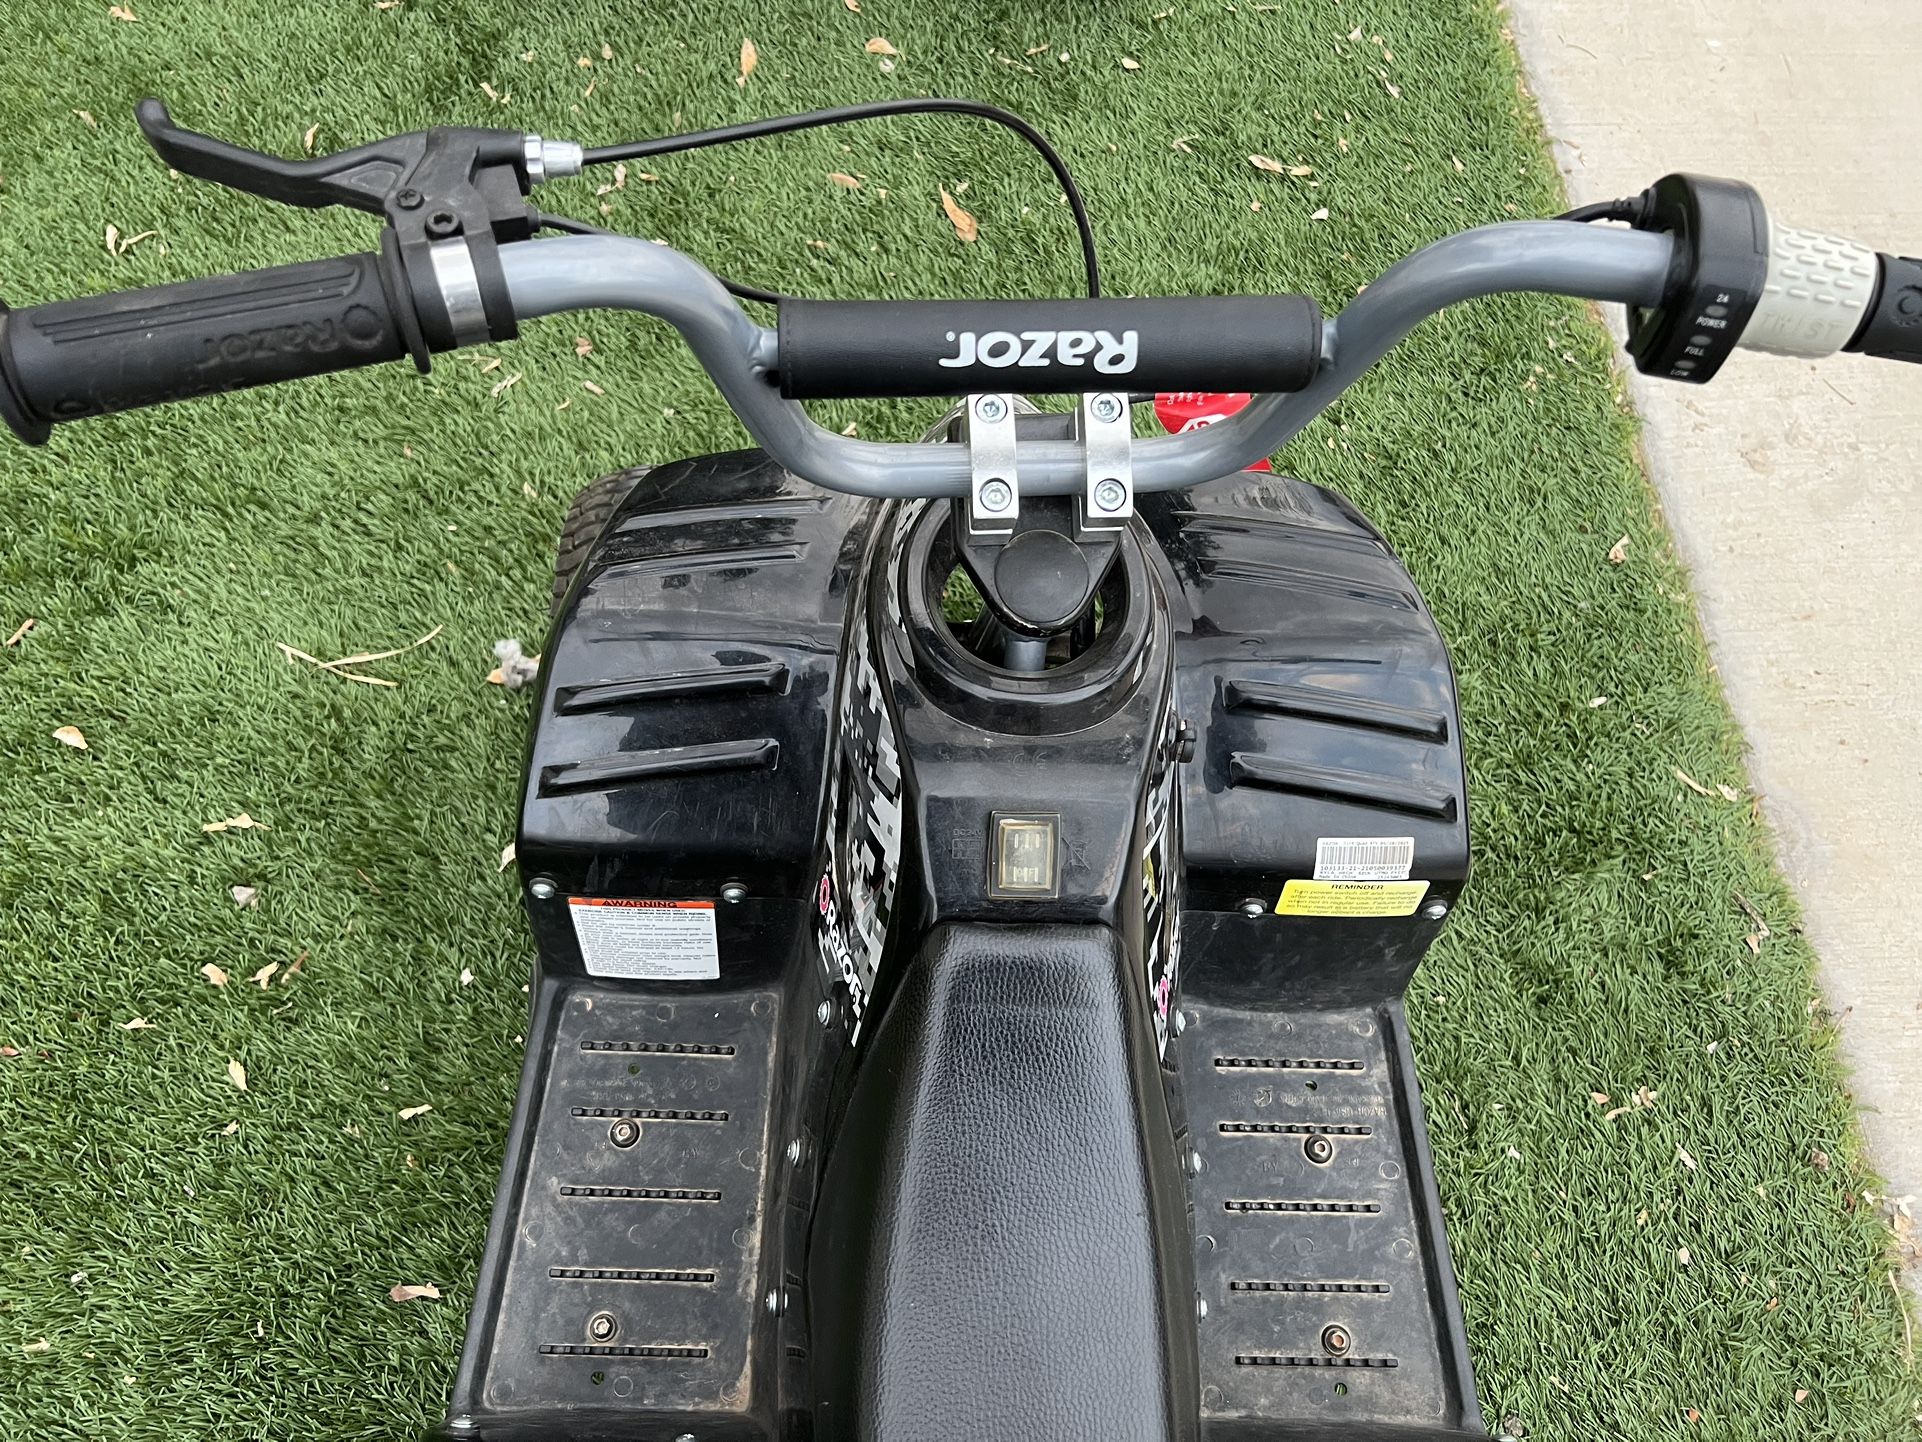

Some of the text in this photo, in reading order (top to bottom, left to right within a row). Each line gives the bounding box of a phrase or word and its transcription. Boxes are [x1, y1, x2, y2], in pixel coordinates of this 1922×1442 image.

[1696, 315, 1728, 329] POWER
[195, 319, 337, 371] Razor
[1684, 345, 1705, 357] FULL
[612, 900, 678, 908] WARNING
